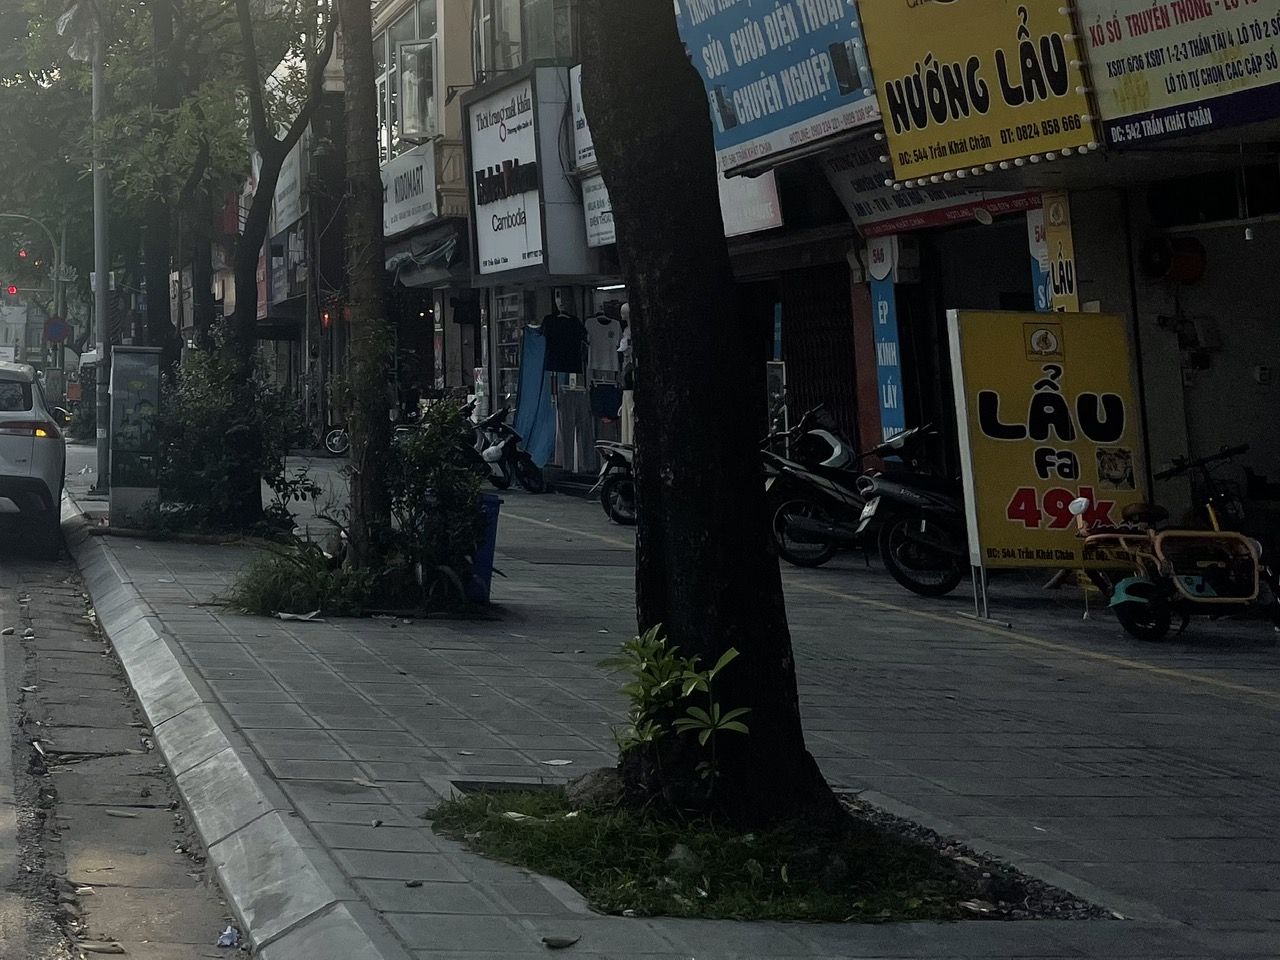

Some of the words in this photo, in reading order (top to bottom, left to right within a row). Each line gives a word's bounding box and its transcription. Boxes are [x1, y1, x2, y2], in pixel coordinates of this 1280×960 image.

[701, 33, 730, 80] SỬA
[730, 16, 766, 67] CHỮA
[763, 1, 800, 52] ĐIỆN
[1088, 14, 1105, 48] XỔ
[1105, 10, 1122, 43] SỐ
[1237, 22, 1251, 46] LÔ
[1251, 19, 1263, 41] TÔ
[1262, 20, 1271, 38] 2
[733, 70, 782, 125] CHUYÊN
[780, 48, 832, 106] NGHIỆP
[883, 50, 991, 136] NƯỚNG
[993, 5, 1070, 109] LẨU
[1165, 71, 1177, 95] LÔ
[1265, 45, 1278, 70] SỐ
[1016, 122, 1040, 142] 0824
[1041, 118, 1061, 137] 858
[1062, 113, 1082, 132] 666
[1125, 123, 1141, 139] 542
[1186, 106, 1213, 128] CHÂN
[913, 147, 929, 164] 544
[394, 164, 425, 204] KIDOMART
[491, 207, 526, 232] Cambodia
[1050, 240, 1076, 295] LẨU
[877, 294, 889, 325] ÉP
[877, 337, 898, 367] KÍNH
[882, 375, 898, 409] LẤY
[976, 362, 1126, 444] LẨU
[1033, 446, 1081, 482] Fa
